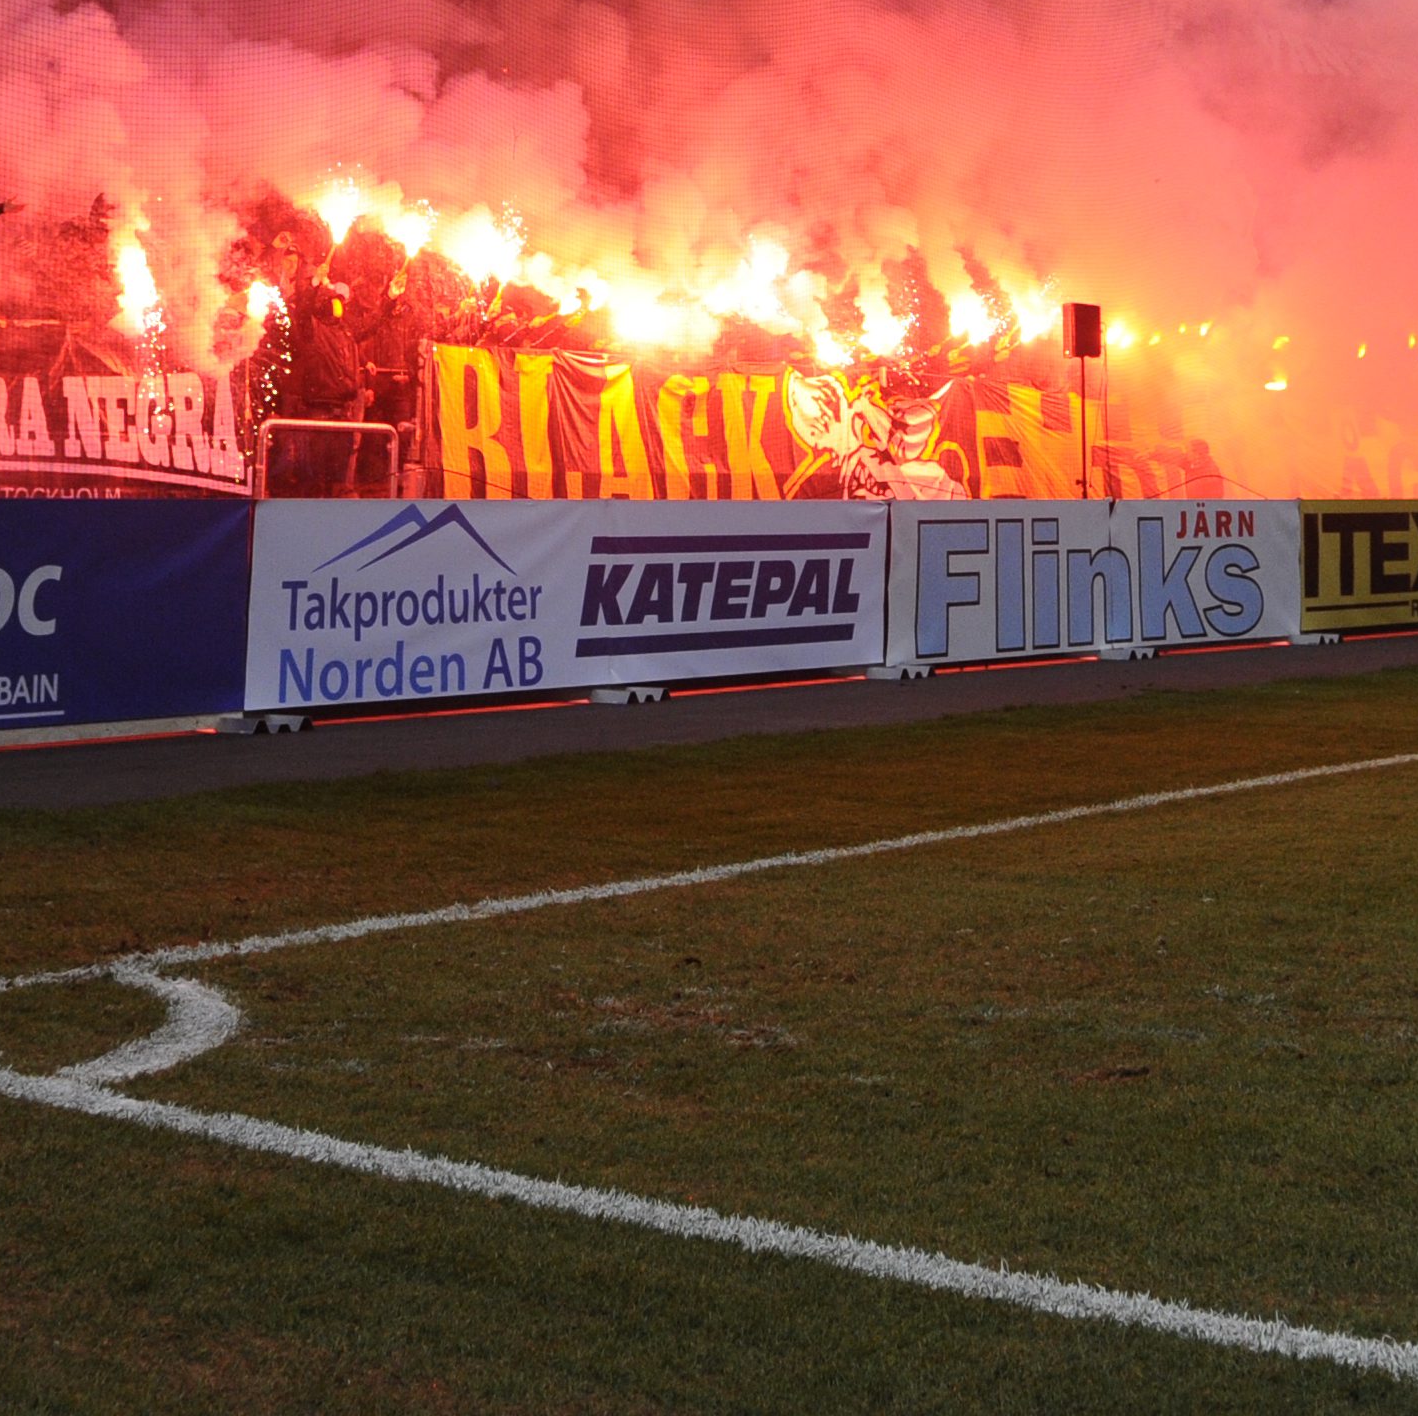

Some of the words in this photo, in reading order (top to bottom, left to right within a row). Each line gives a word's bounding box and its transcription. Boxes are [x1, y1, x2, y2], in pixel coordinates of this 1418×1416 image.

[63, 370, 247, 480] NEGRA
[1176, 503, 1255, 538] JÄRN
[283, 573, 542, 640] Takprodukter
[580, 557, 861, 626] KATEPAL
[914, 516, 1264, 658] Flinks
[278, 639, 466, 703] Norden
[483, 636, 543, 690] AB
